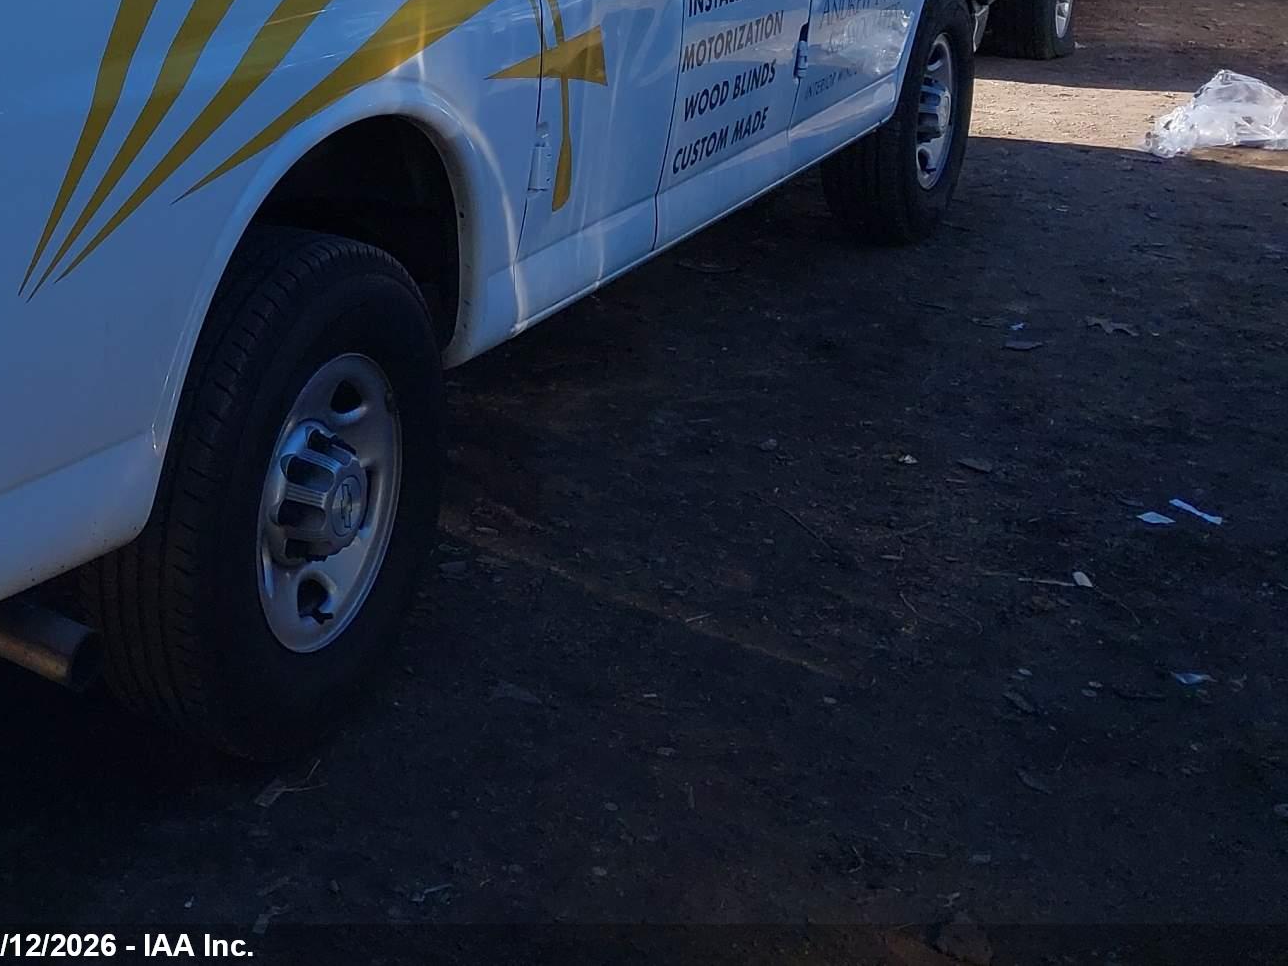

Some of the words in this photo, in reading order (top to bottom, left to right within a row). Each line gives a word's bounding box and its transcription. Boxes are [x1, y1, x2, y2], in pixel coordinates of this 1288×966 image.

[682, 10, 784, 73] MOTORIZATION
[684, 80, 729, 122] WOOD
[732, 58, 776, 100] BLINDS
[673, 126, 729, 174] CUSTOM
[731, 107, 768, 145] MADE
